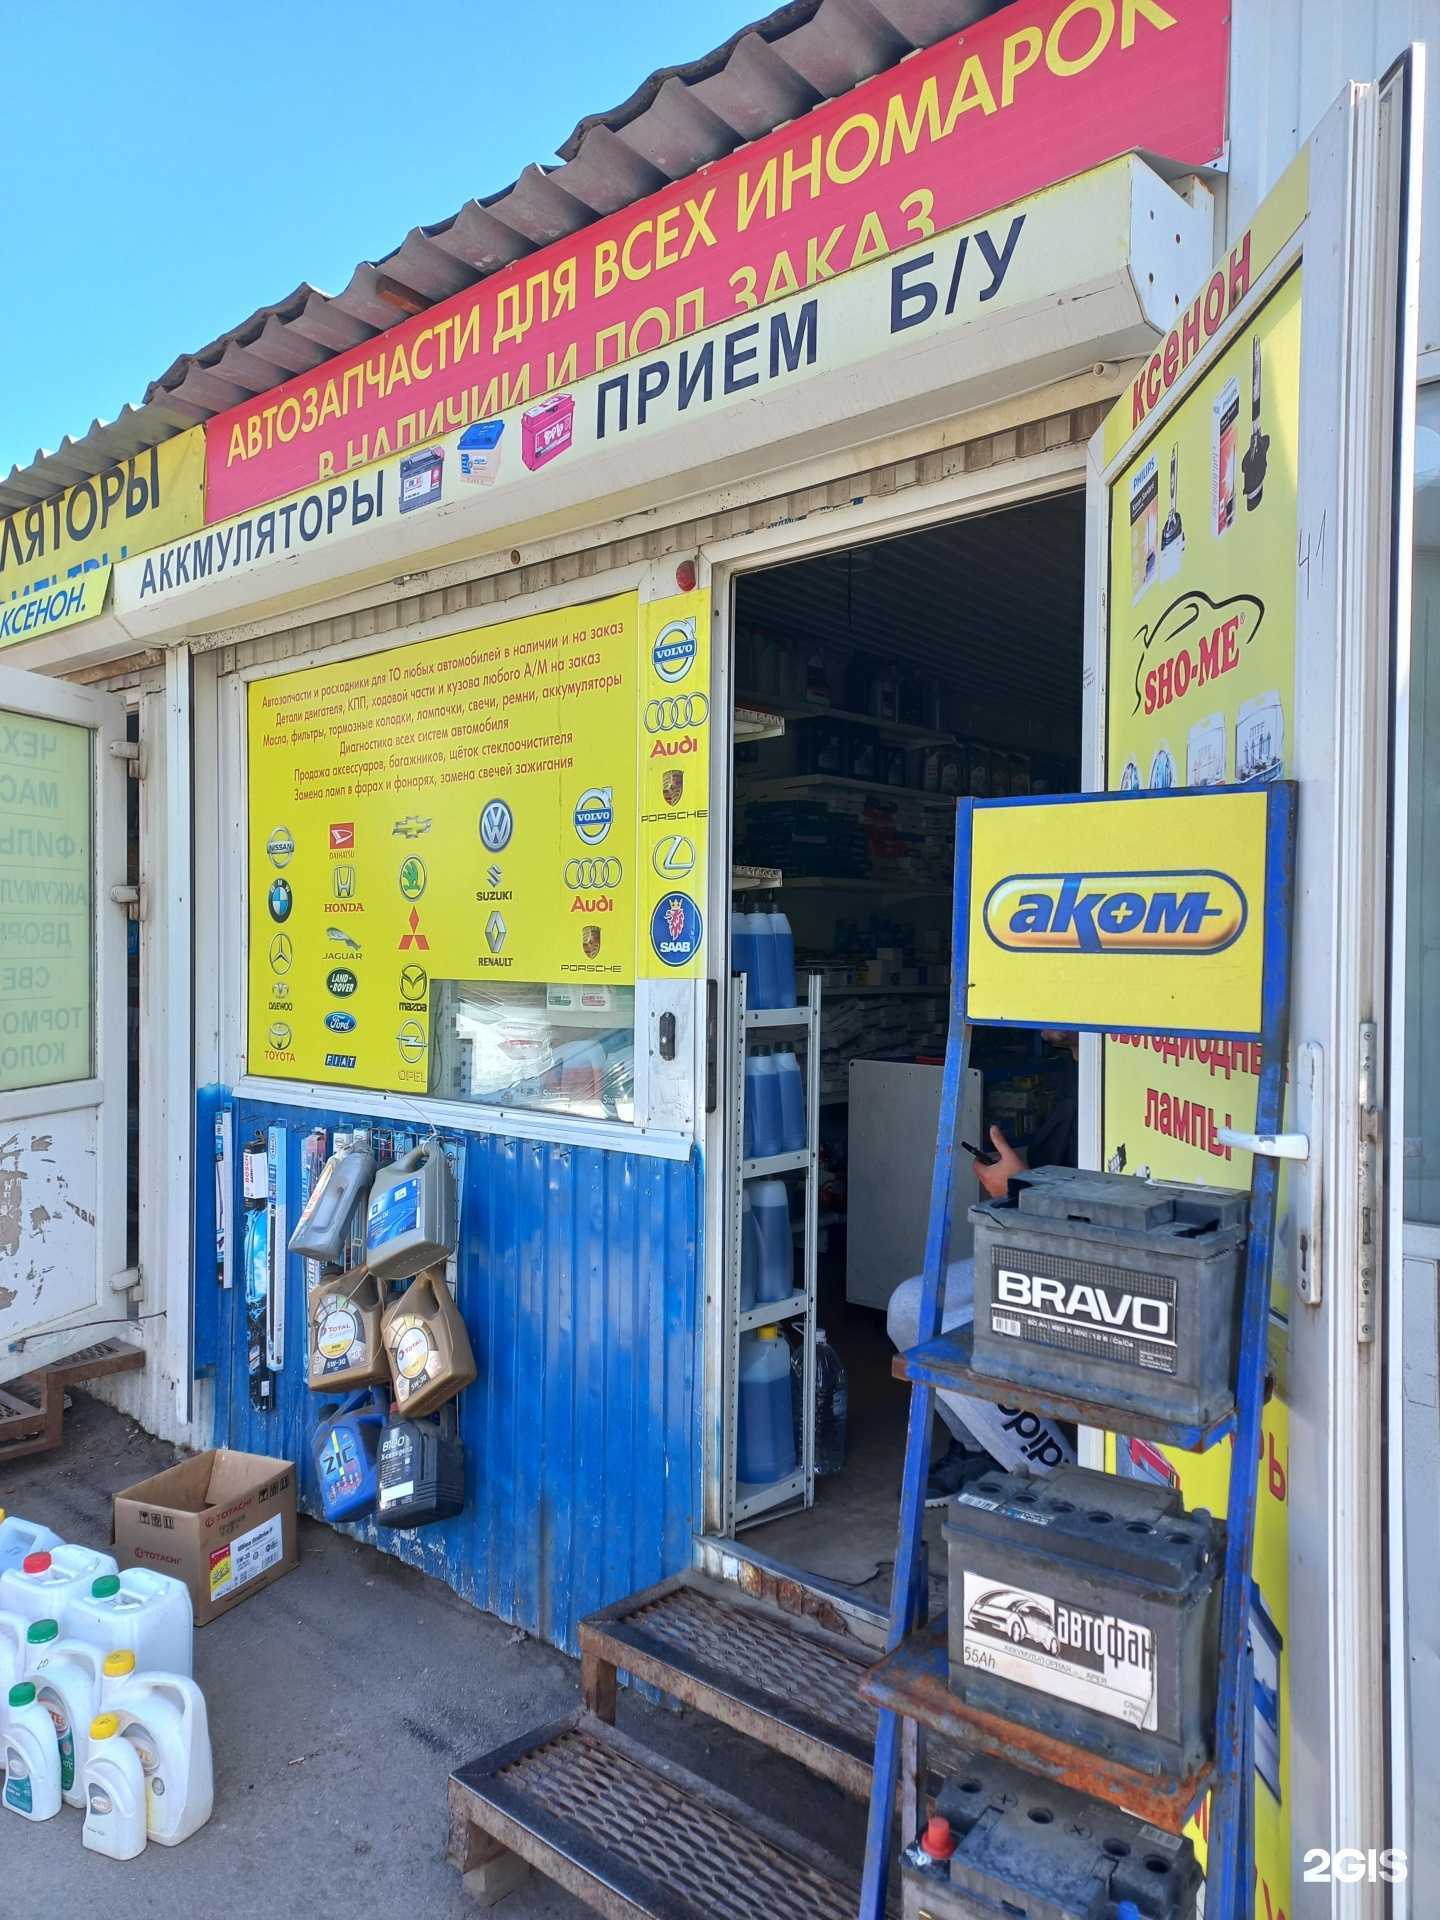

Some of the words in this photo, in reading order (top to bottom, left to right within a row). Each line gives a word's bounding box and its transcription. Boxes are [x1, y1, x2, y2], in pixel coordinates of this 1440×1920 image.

[226, 304, 481, 468] АВТОЗАПЧАСТИ
[492, 257, 577, 354] ДЛЯ
[594, 188, 719, 299] ВСЕХ
[736, 0, 1179, 233] ИНОМАРОК
[140, 470, 384, 599] АККМУЛЯТОРЫ
[596, 299, 818, 440] ПРИЕМ
[890, 213, 1026, 335] Б/У
[1132, 455, 1155, 492] PHILIPS
[656, 643, 694, 659] VOLVO
[262, 688, 311, 709] Автозапчасти
[313, 688, 319, 699] и
[321, 680, 369, 701] расходники
[372, 674, 386, 687] для
[389, 667, 401, 682] ТО
[403, 661, 434, 680] любых
[437, 646, 501, 673] автомобилей
[504, 647, 510, 659] в
[513, 636, 558, 656] наличии
[562, 633, 569, 646] и
[572, 630, 587, 643] на
[590, 622, 624, 640] заказ
[1144, 615, 1240, 716] SHO-ME
[276, 711, 303, 728] Детали
[304, 702, 345, 721] двигателя,
[348, 696, 369, 712] КПП,
[372, 689, 408, 707] ходовой
[410, 685, 435, 701] части
[438, 683, 444, 695] и
[447, 677, 480, 696] кузова
[483, 667, 521, 684] любого
[524, 658, 548, 679] А/М
[551, 661, 564, 672] на
[568, 652, 601, 670] заказ
[263, 734, 289, 748] Масло,
[291, 727, 326, 747] фильтры,
[329, 719, 373, 738] тормозные
[376, 712, 414, 729] колодки,
[417, 703, 465, 721] лампочки,
[468, 695, 499, 712] свечи,
[502, 691, 539, 711] ремни,
[542, 674, 622, 701] аккумуляторы
[340, 737, 393, 757] Диагностика
[395, 733, 415, 745] всех
[417, 729, 449, 745] систем
[451, 717, 509, 738] автомобиля
[649, 736, 698, 758] Audi
[294, 767, 330, 786] Продажа
[332, 759, 386, 778] аксессуаров,
[389, 751, 447, 770] багажников,
[482, 732, 573, 756] стеклоочистителя
[294, 787, 324, 801] Замена
[325, 784, 346, 799] ламп
[354, 780, 384, 799] фарах
[394, 773, 437, 793] фонарях,
[440, 769, 475, 784] замена
[478, 762, 512, 780] свечей
[515, 756, 573, 775] зажигания
[576, 810, 610, 823] VOLVO
[640, 809, 709, 823] PORSCHE
[268, 842, 293, 852] NISSAN
[328, 850, 355, 860] DAIHATSU
[476, 890, 513, 902] SUZUKI
[323, 903, 365, 913] HONDA
[570, 896, 614, 913] Audi
[659, 941, 692, 953] SAAB
[321, 952, 363, 961] JAGUAR
[478, 957, 514, 967] RENAULT
[561, 963, 623, 973] PORSCHE
[268, 1002, 293, 1012] DAEWOO
[329, 1015, 351, 1031] Ford
[264, 1050, 296, 1063] TOYOTA
[326, 1055, 356, 1068] FIAT
[397, 1070, 426, 1083] OPEL
[1144, 1087, 1231, 1161] лампы
[998, 1269, 1168, 1335] BRAVO
[329, 1325, 350, 1333] TOTAL
[326, 1359, 346, 1369] 5W-30
[323, 1444, 354, 1475] ZIC
[144, 1550, 180, 1565] TOTACHI
[964, 1646, 996, 1670] 55Ah
